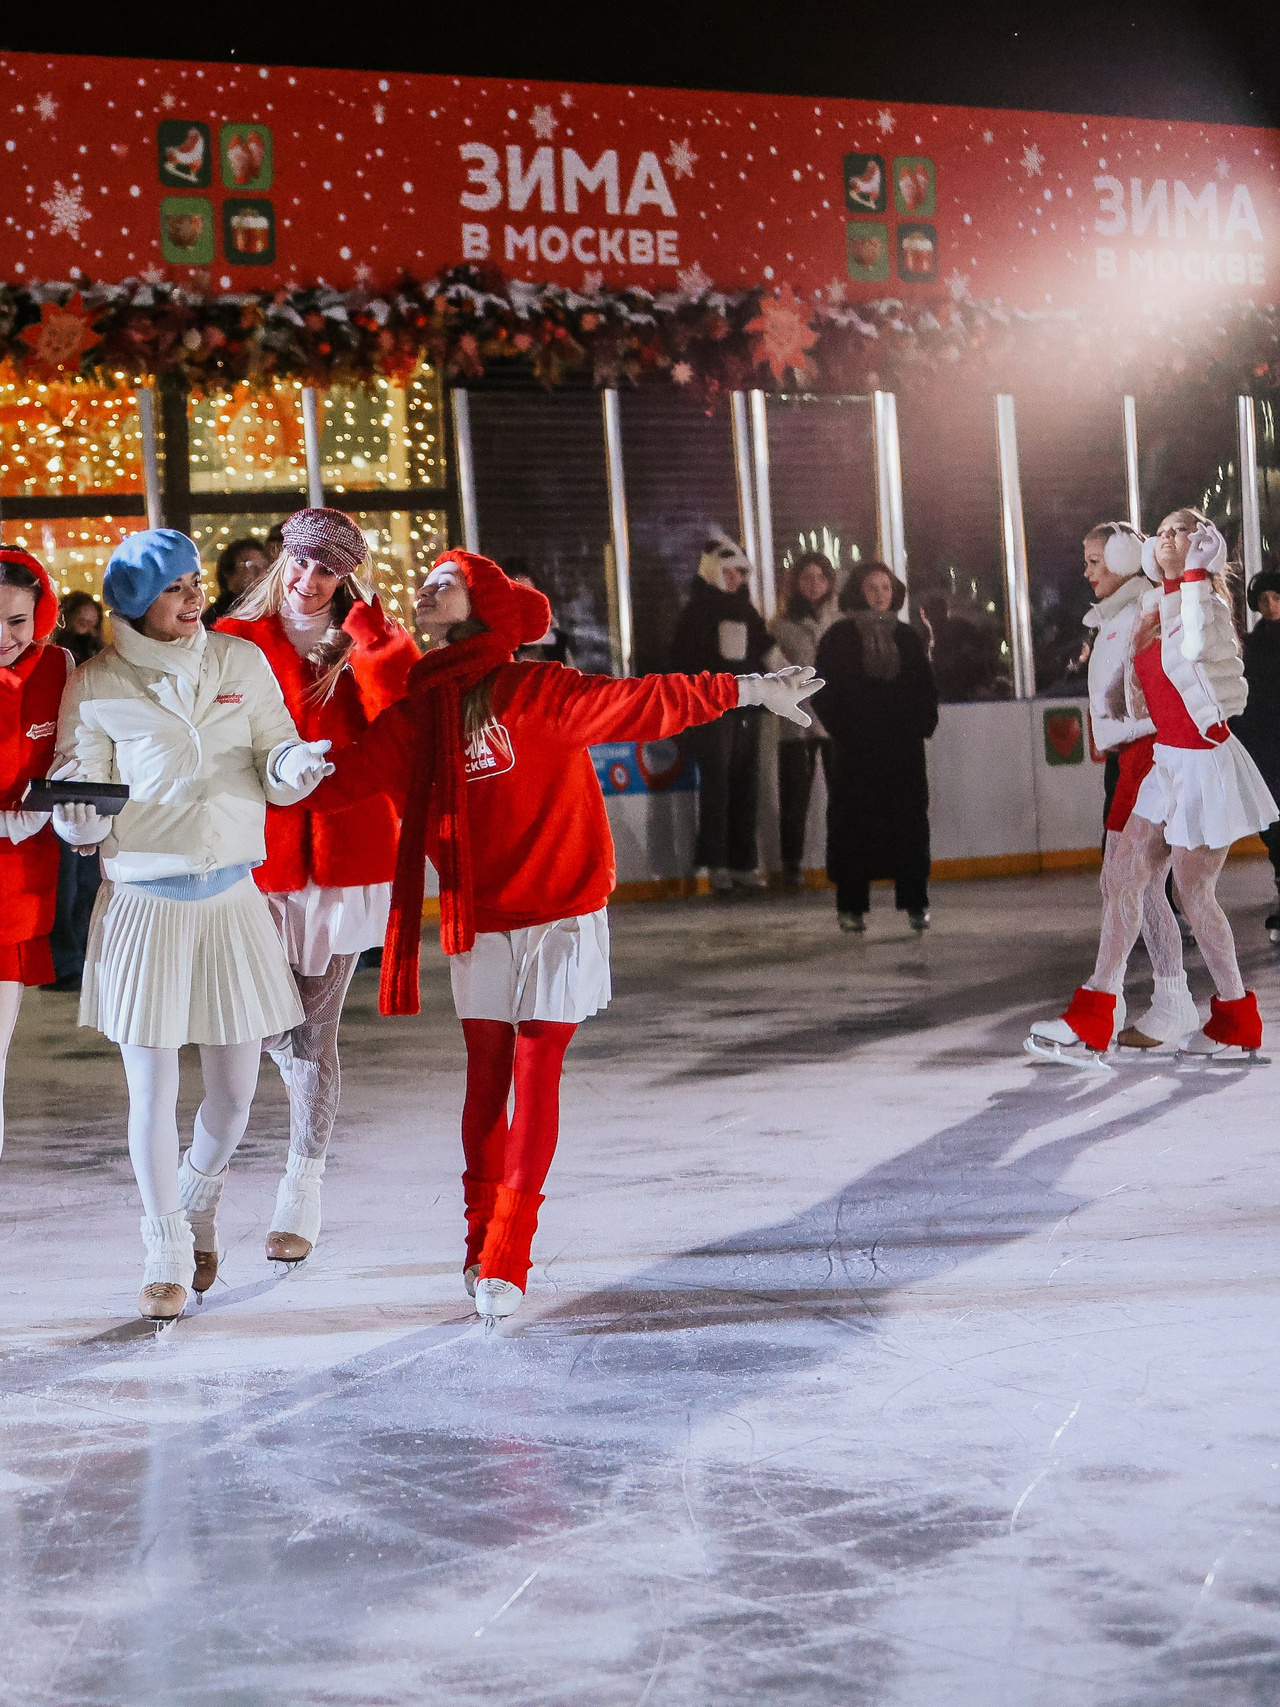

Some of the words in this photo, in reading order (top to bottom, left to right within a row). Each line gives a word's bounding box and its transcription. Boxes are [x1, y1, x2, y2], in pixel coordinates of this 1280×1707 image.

[458, 142, 678, 217] ЗИМА
[1093, 174, 1263, 242] ЗИМА
[462, 223, 490, 260] В
[504, 225, 680, 266] МОСКВЕ
[1095, 247, 1118, 280] В
[1128, 248, 1266, 285] МОСКВЕ
